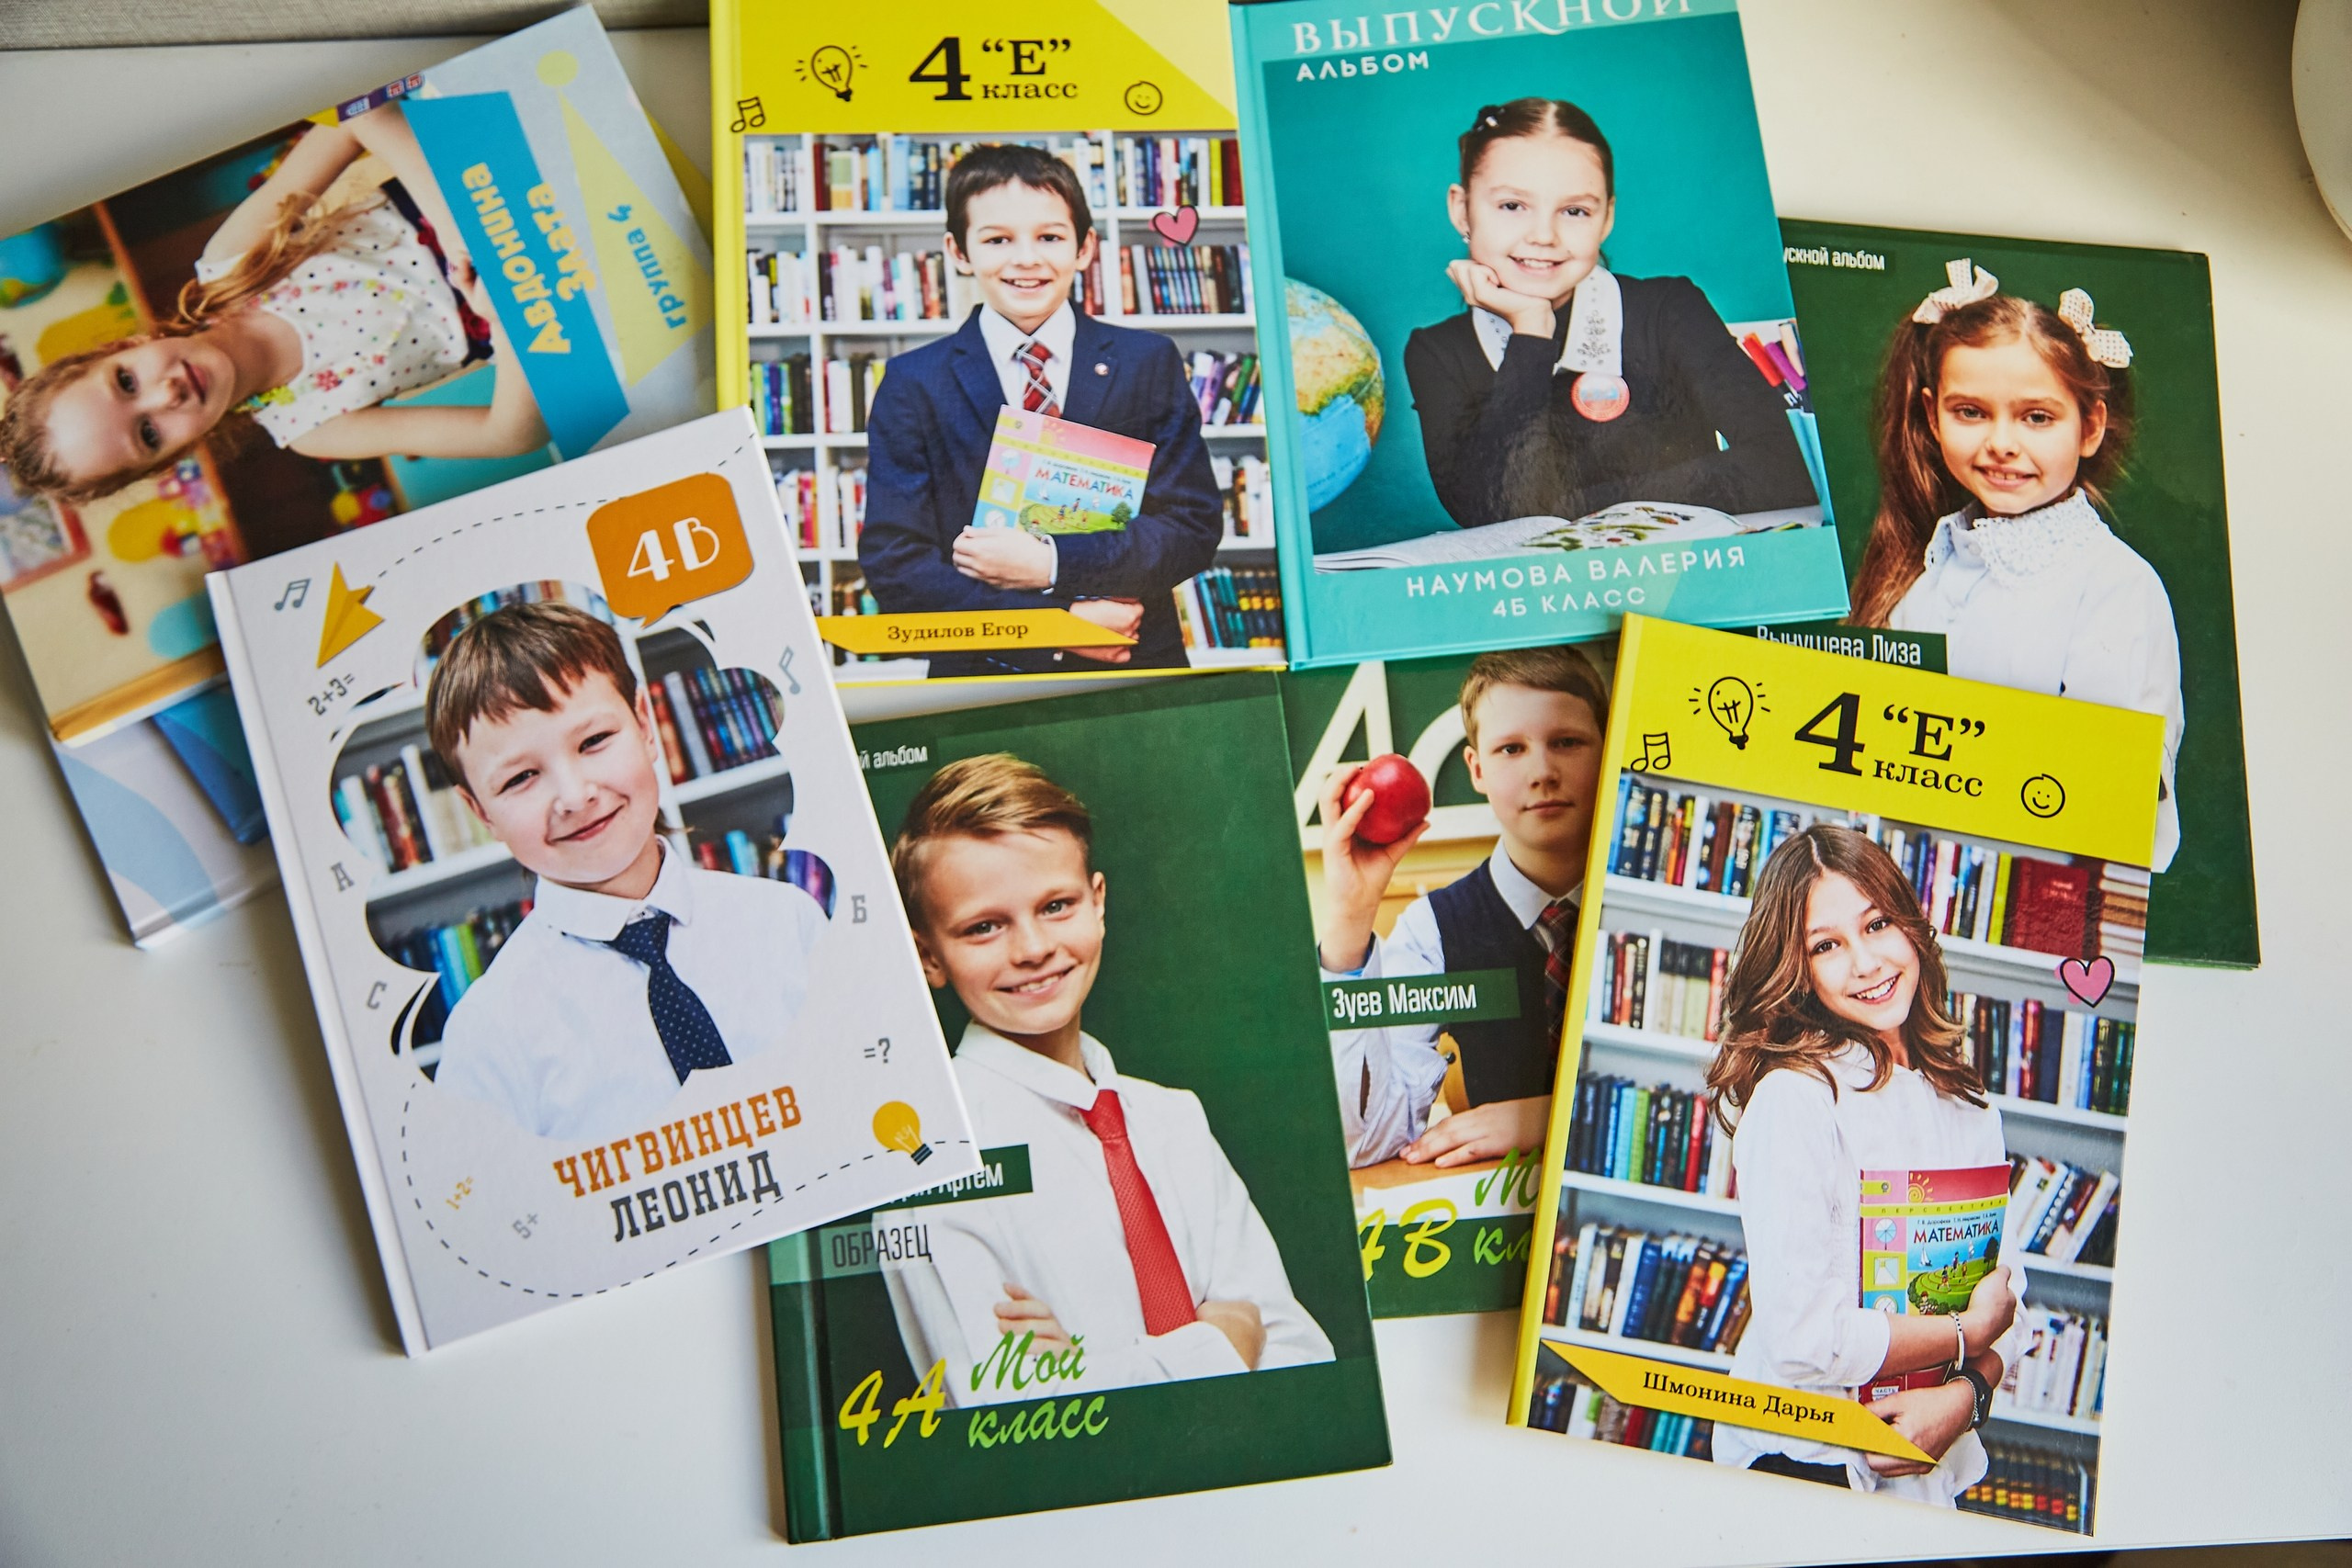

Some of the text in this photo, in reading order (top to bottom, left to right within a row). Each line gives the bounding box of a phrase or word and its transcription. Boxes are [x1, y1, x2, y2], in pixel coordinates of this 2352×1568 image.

[910, 37, 973, 101] 4
[1295, 51, 1430, 82] АЛЬБОМ
[981, 82, 1079, 99] класс
[461, 162, 571, 354] Авдонина
[526, 182, 596, 301] Злата
[1831, 249, 1885, 271] альбом
[607, 204, 687, 330] группа 4
[1035, 468, 1134, 501] МАТЕМАТИКА
[1406, 546, 1747, 598] НАУМОВА ВАЛЕРИЯ
[1492, 586, 1646, 618] 4Б КЛАСС
[888, 622, 1029, 644] Зудилов Егор
[1871, 634, 1922, 666] Лиза
[1793, 691, 1866, 777] 4
[873, 744, 929, 770] альбом
[1872, 759, 1984, 798] класс
[1332, 983, 1477, 1024] Зуев Максим
[553, 1085, 802, 1198] ЧИГВИНЦЕВ
[610, 1150, 782, 1242] ЛЕОНИД
[831, 1224, 933, 1269] ОБРАЗЕЦ
[1913, 1219, 2000, 1244] МАТЕМАТИКА
[970, 1329, 1087, 1393] Мой
[1643, 1371, 1836, 1424] Шмонина Дарья
[967, 1394, 1110, 1450] класс
